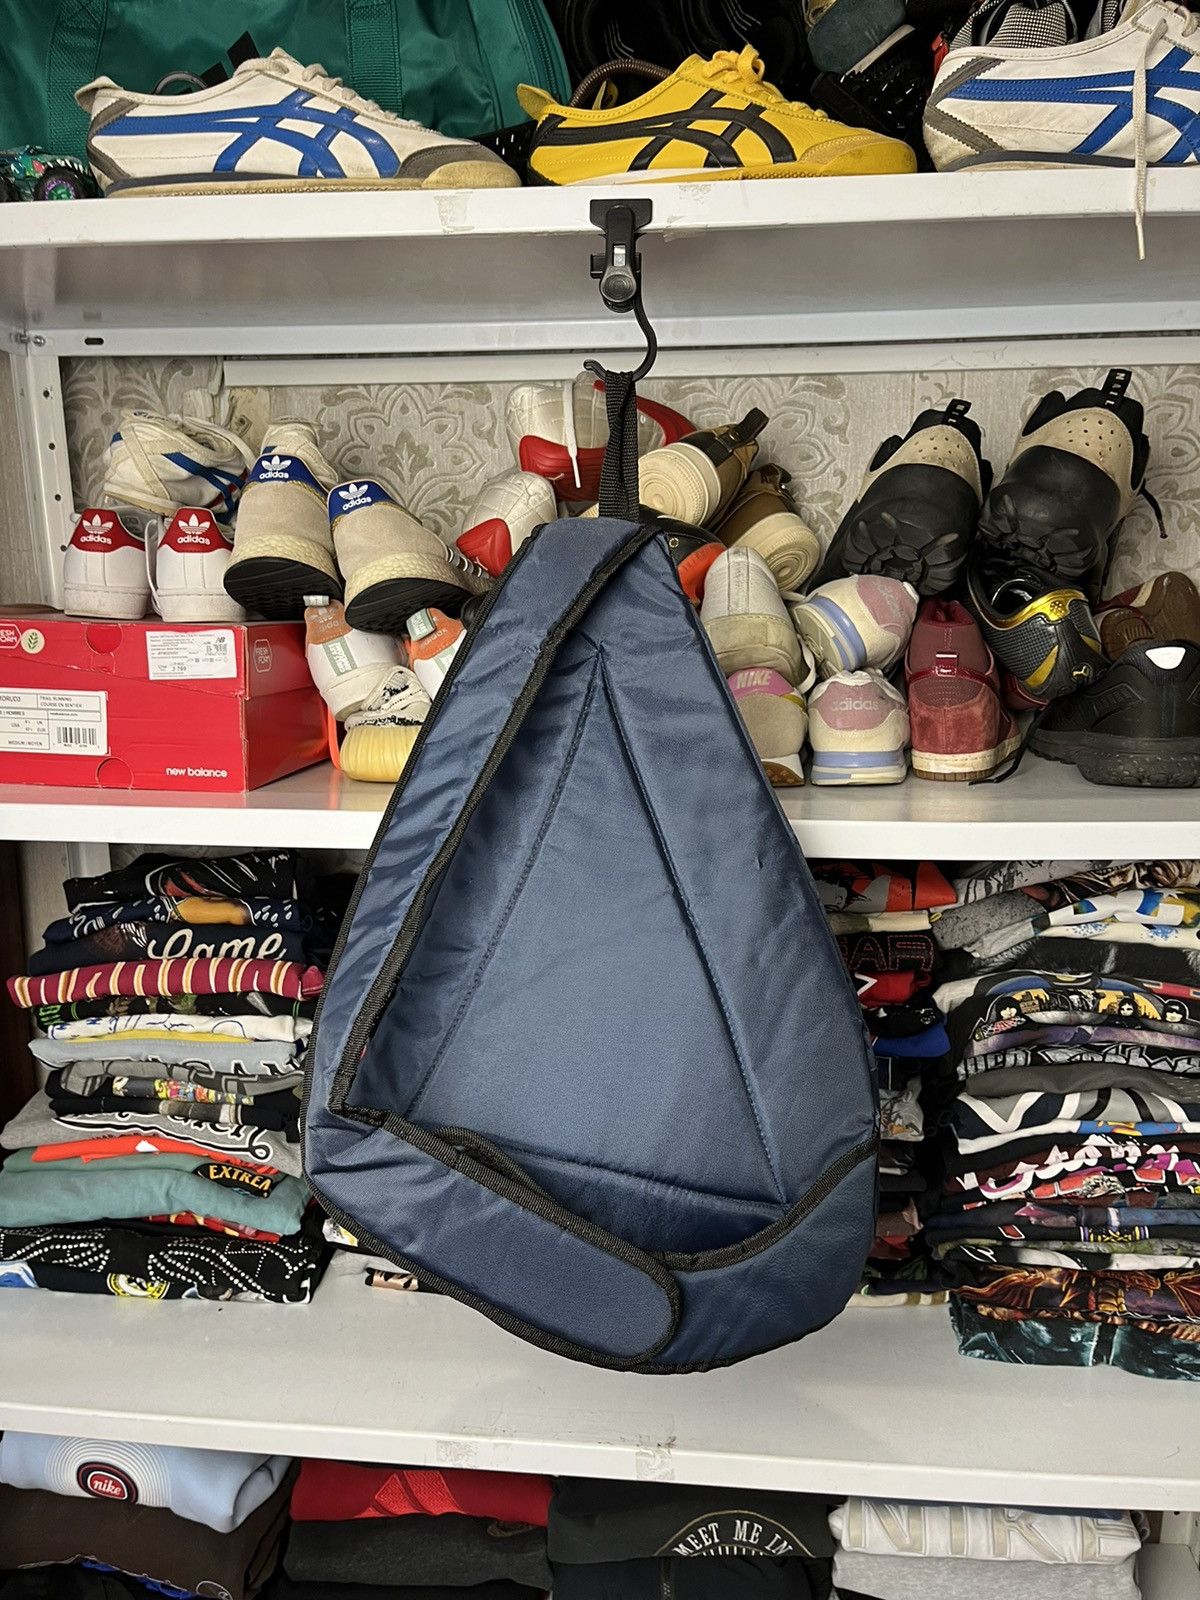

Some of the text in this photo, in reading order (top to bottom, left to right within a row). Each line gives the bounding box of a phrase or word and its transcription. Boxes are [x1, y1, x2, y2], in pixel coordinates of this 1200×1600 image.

[259, 470, 289, 479] adidas
[342, 496, 372, 511] adidas
[80, 534, 112, 545] adidas
[177, 534, 210, 545] adidas
[737, 670, 773, 689] NIKE
[166, 766, 228, 778] new balance
[92, 1480, 121, 1495] nike
[672, 1519, 794, 1556] MEET ME IN
[847, 1499, 1137, 1564] NIKE
